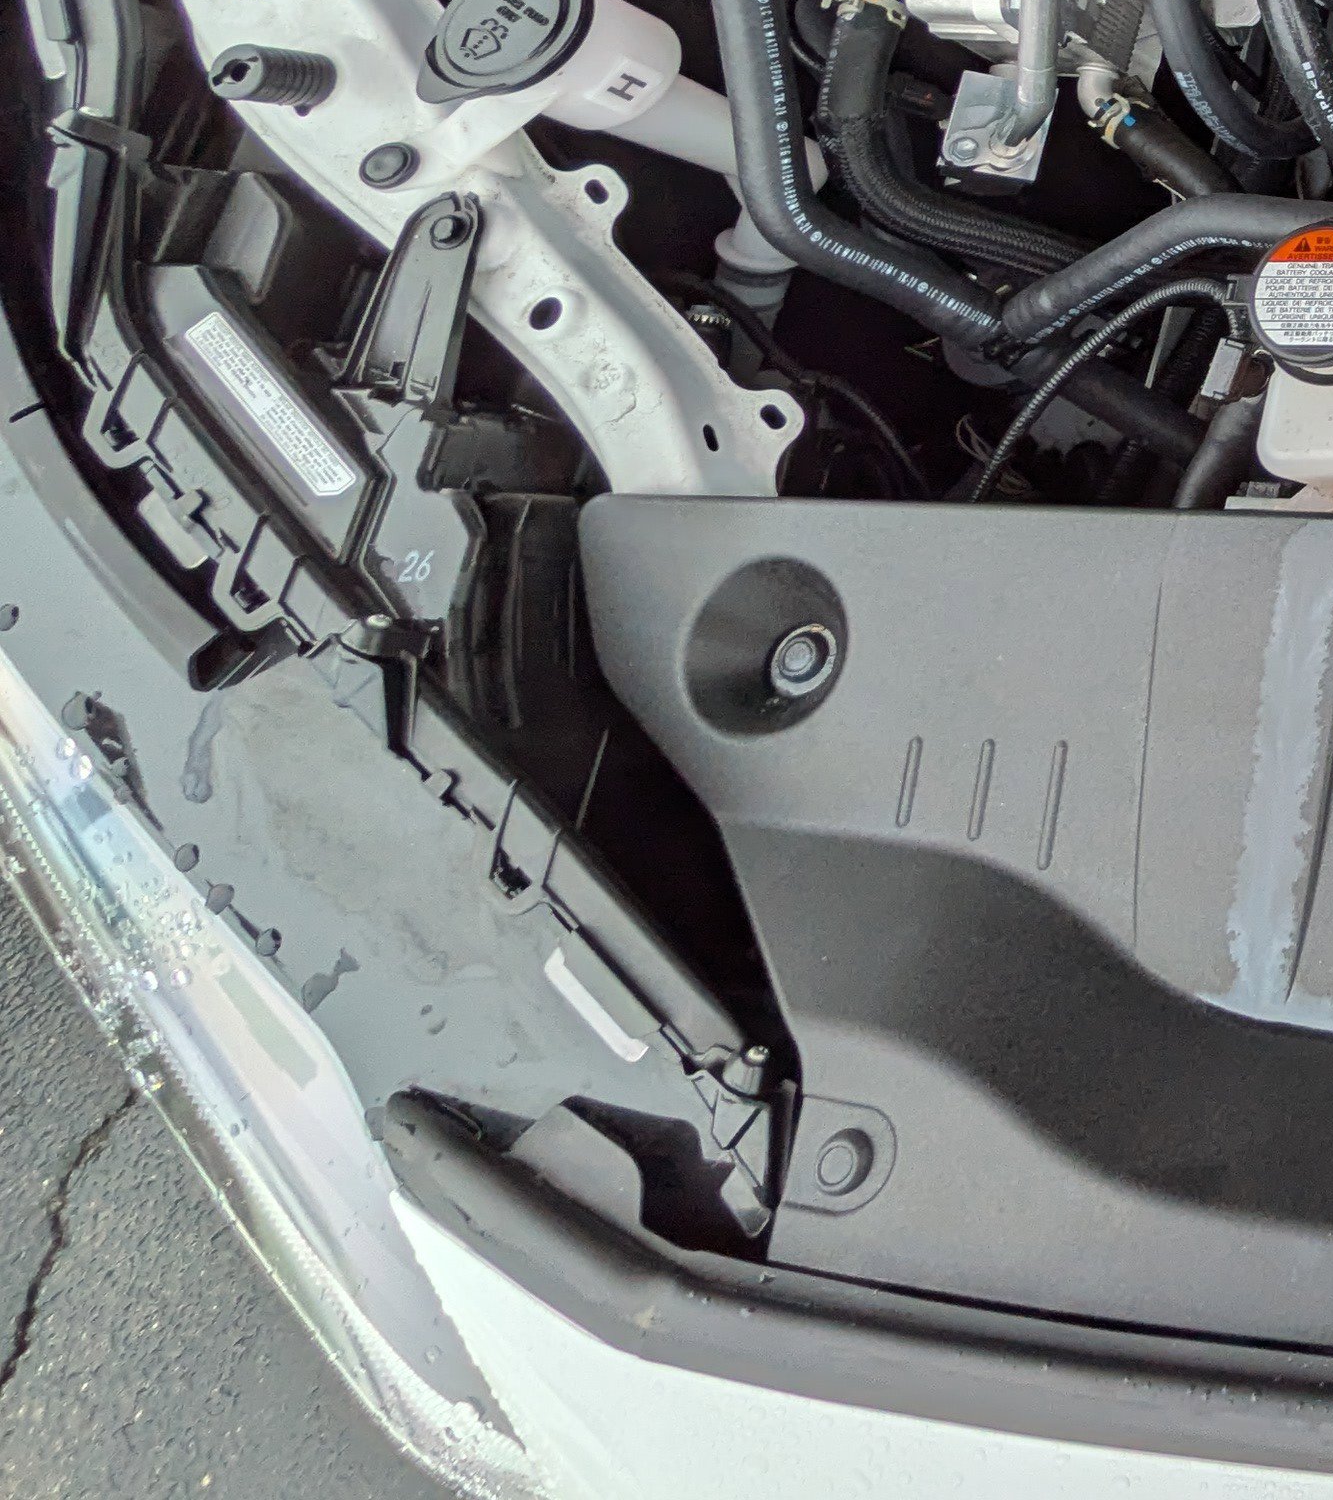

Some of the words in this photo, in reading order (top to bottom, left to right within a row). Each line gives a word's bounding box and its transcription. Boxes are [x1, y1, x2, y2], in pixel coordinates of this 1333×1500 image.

[764, 30, 779, 60] WATER
[607, 73, 647, 101] H
[776, 156, 797, 186] WATER
[398, 550, 434, 582] 26
